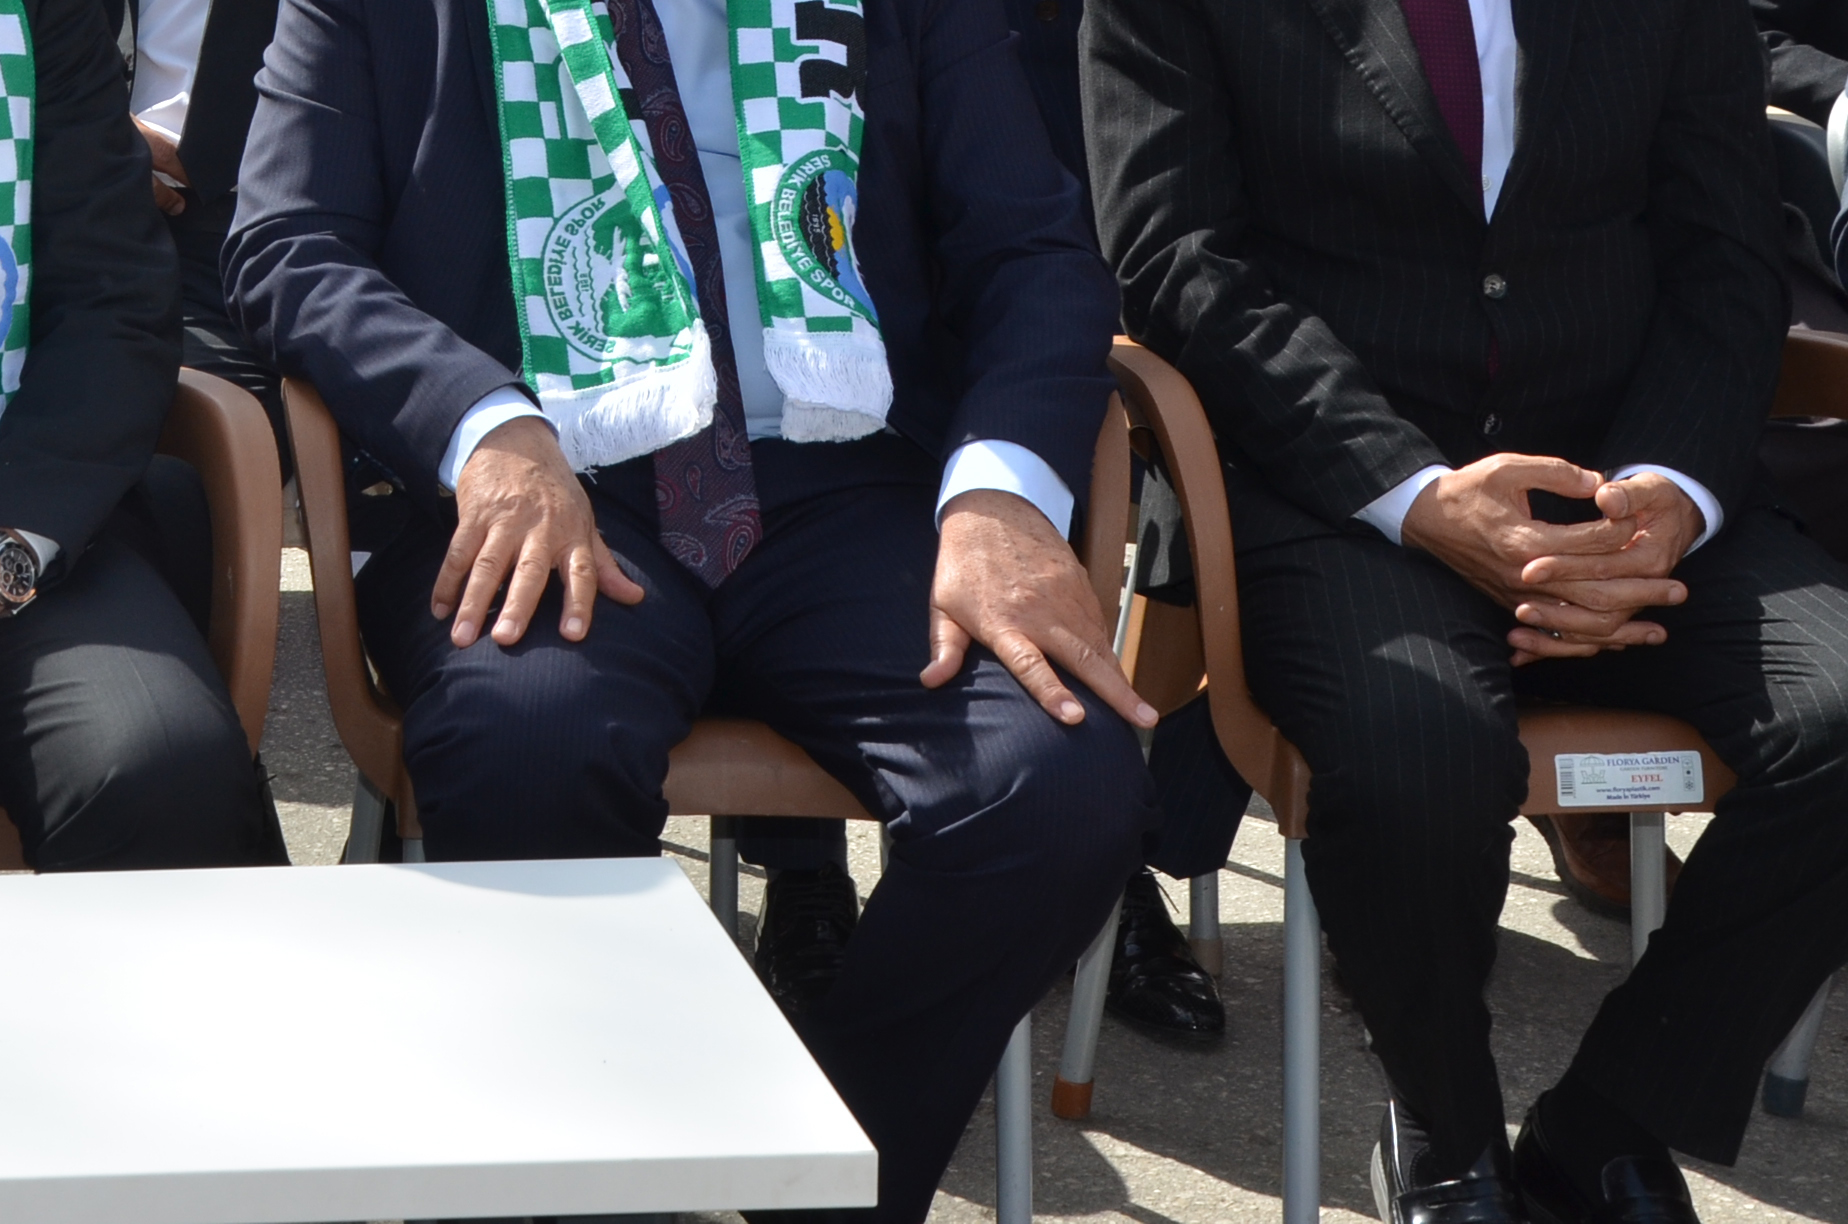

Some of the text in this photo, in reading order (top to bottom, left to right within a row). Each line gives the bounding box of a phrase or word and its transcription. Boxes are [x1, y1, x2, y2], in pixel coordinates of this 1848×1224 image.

[776, 154, 856, 310] SERİK BELEDİYE SPOR
[1606, 755, 1680, 766] FLORYA GARDEN
[1630, 774, 1663, 783] EYFEL
[1606, 793, 1623, 801] Made
